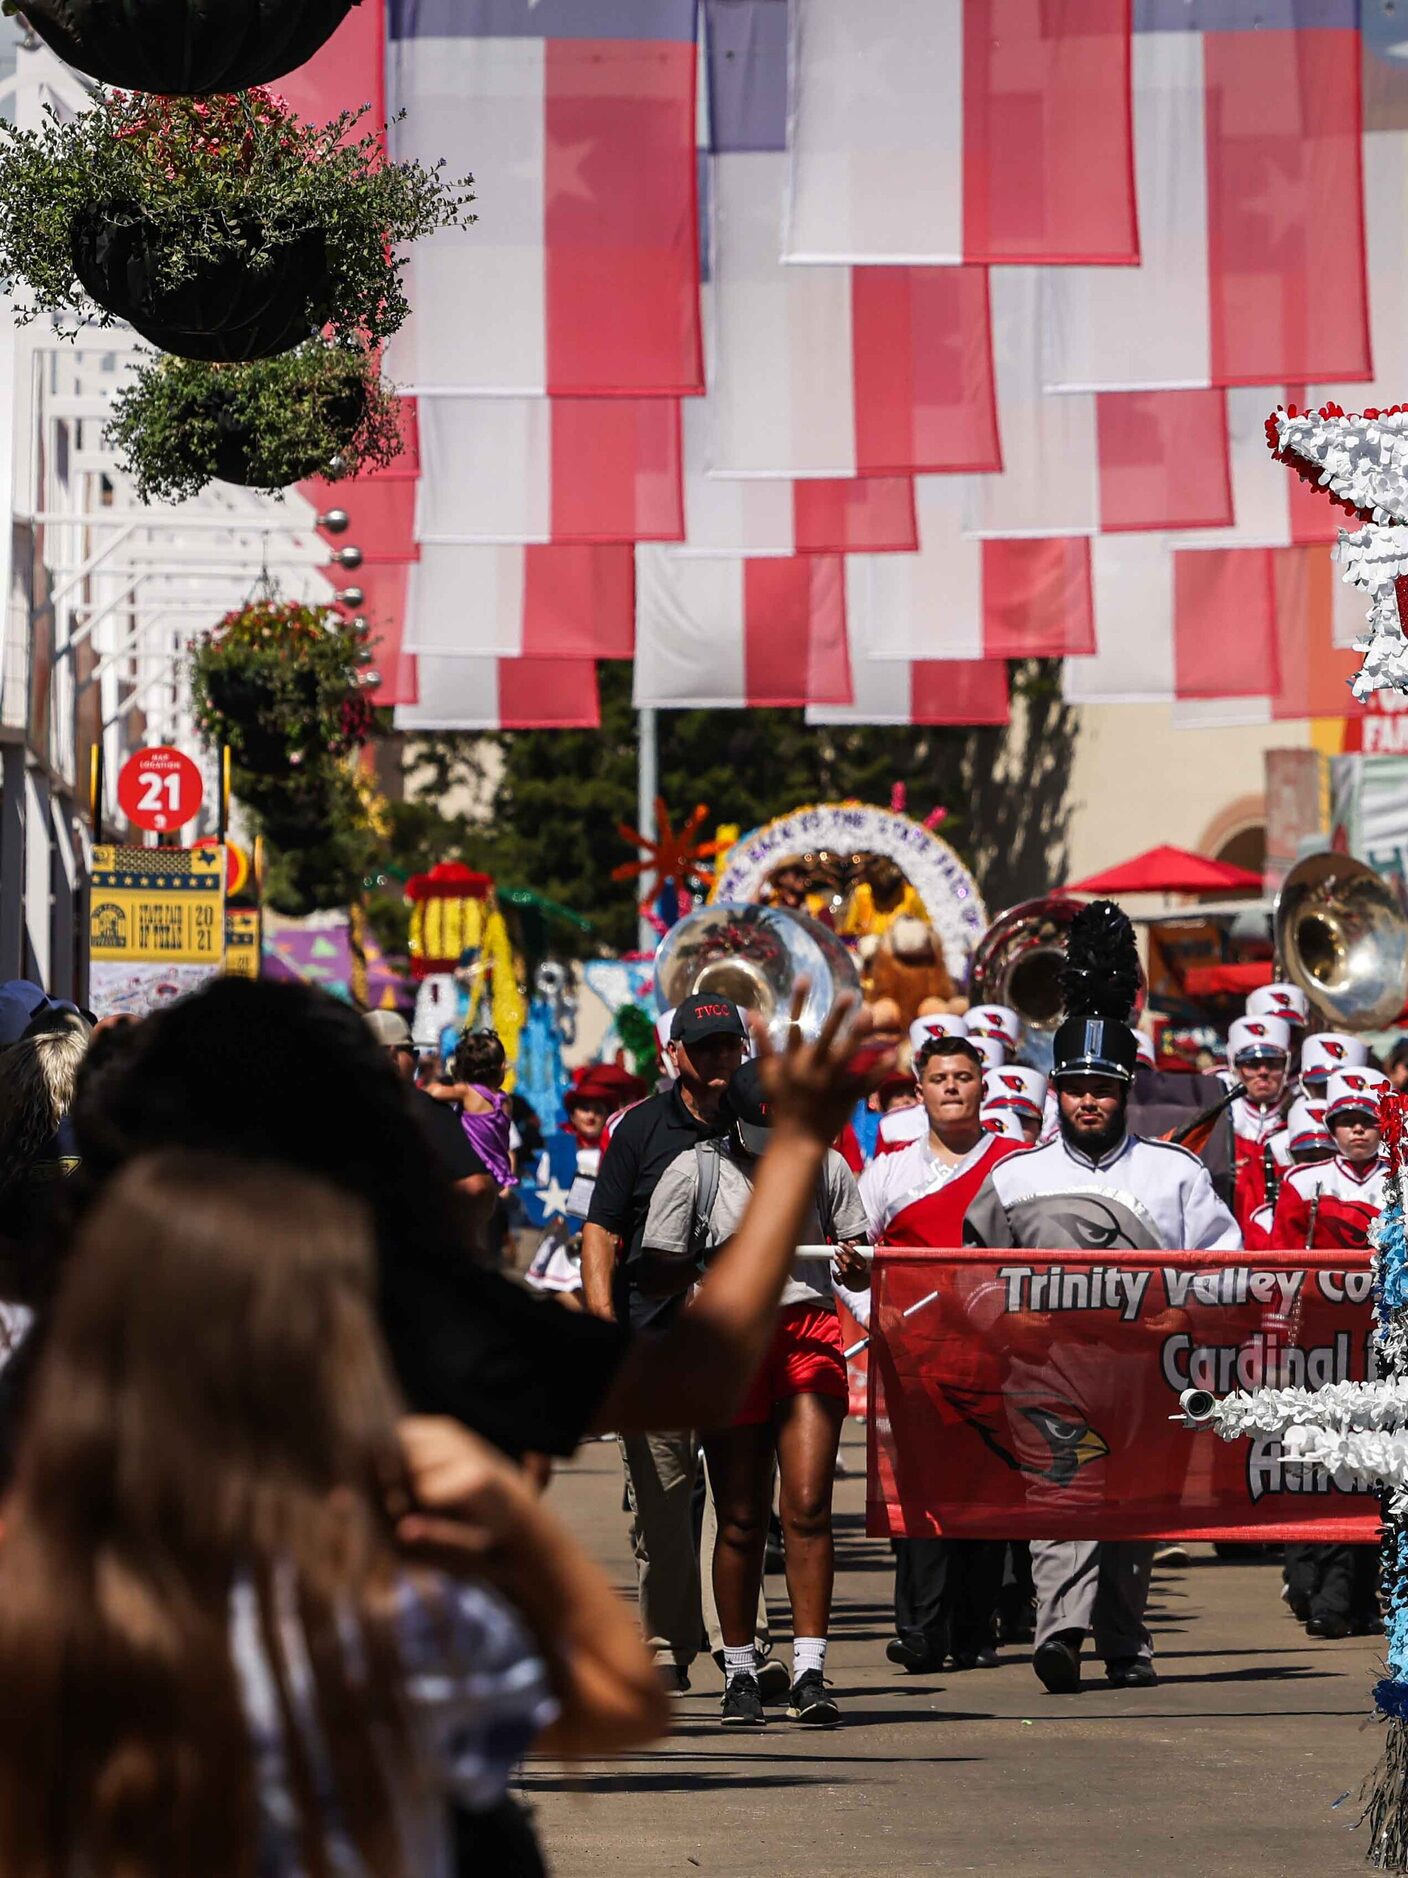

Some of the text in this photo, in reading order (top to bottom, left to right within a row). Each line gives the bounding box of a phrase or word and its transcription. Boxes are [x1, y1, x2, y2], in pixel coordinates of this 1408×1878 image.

[137, 772, 180, 811] 21
[195, 906, 213, 926] 20
[197, 930, 211, 951] 21
[695, 1005, 729, 1019] TVCC
[998, 1266, 1375, 1321] Trinity Valley Co
[1160, 1331, 1352, 1393] Cardinal
